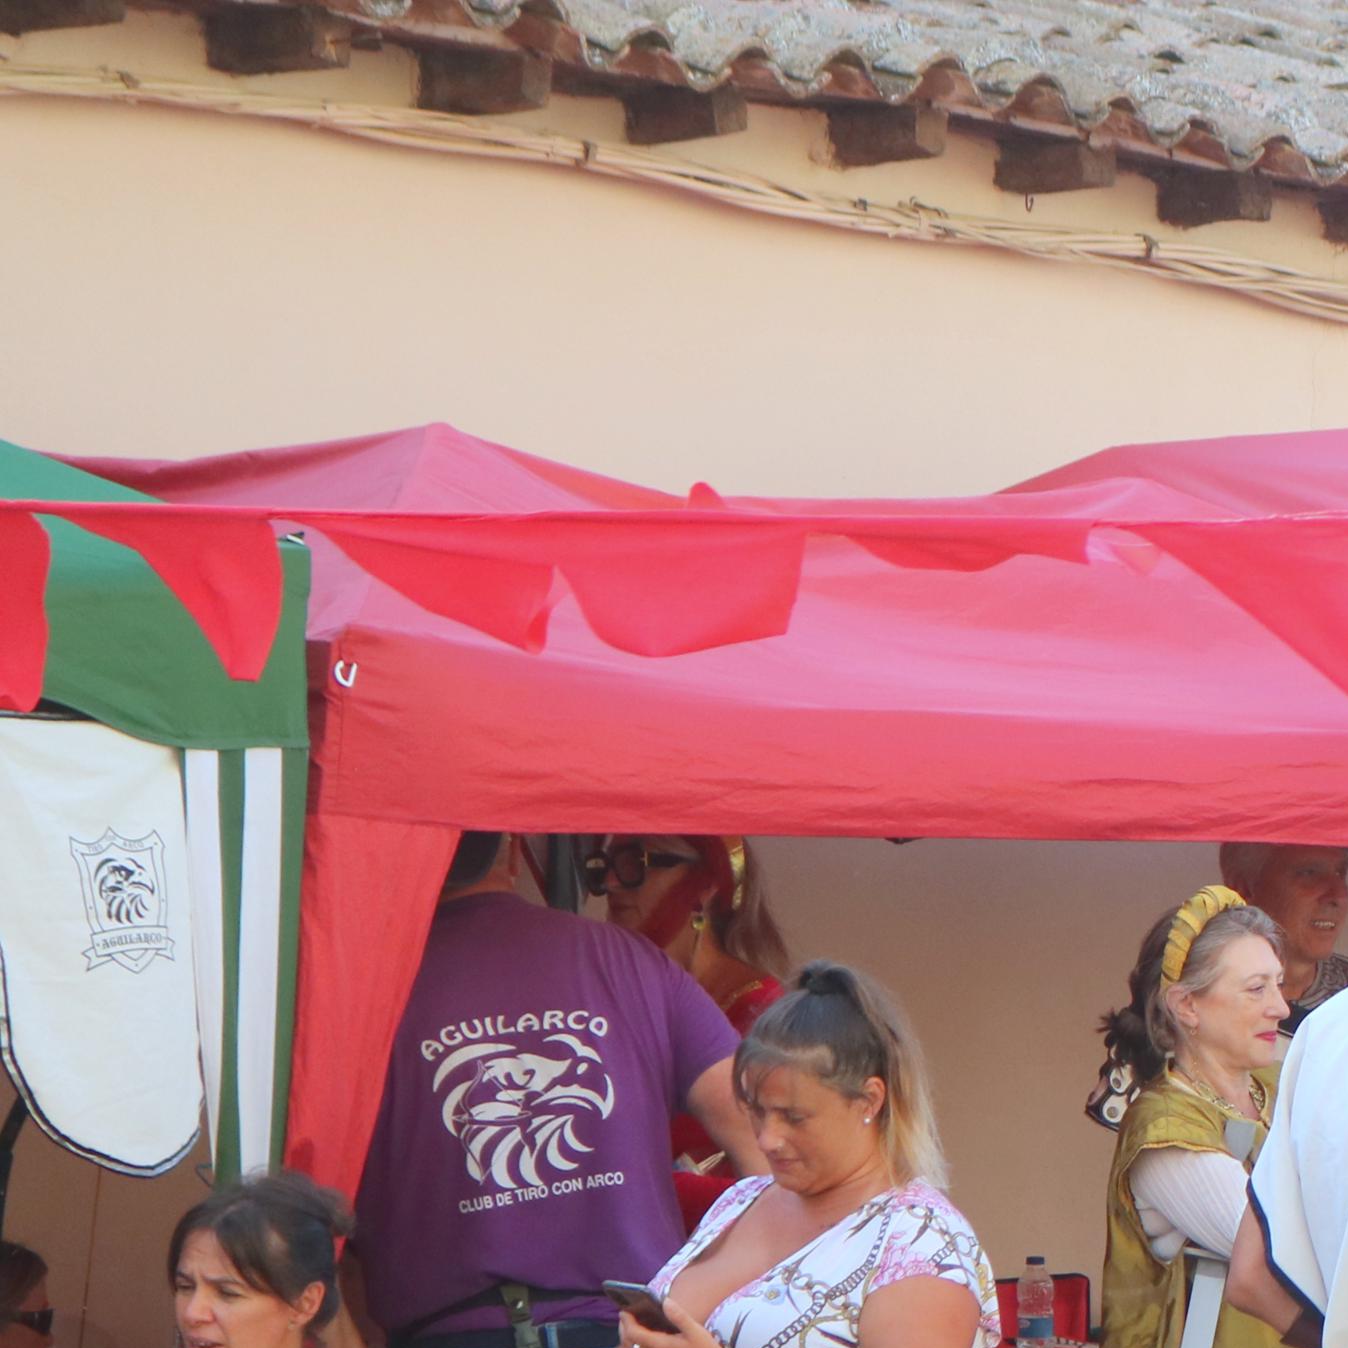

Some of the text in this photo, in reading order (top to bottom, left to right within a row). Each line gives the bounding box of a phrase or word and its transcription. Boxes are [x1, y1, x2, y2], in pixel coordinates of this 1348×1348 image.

[101, 932, 163, 950] AGUILARCO
[420, 1009, 609, 1062] AGUILARCO
[458, 1171, 625, 1214] CLUB DE TIRO CON ARCO
